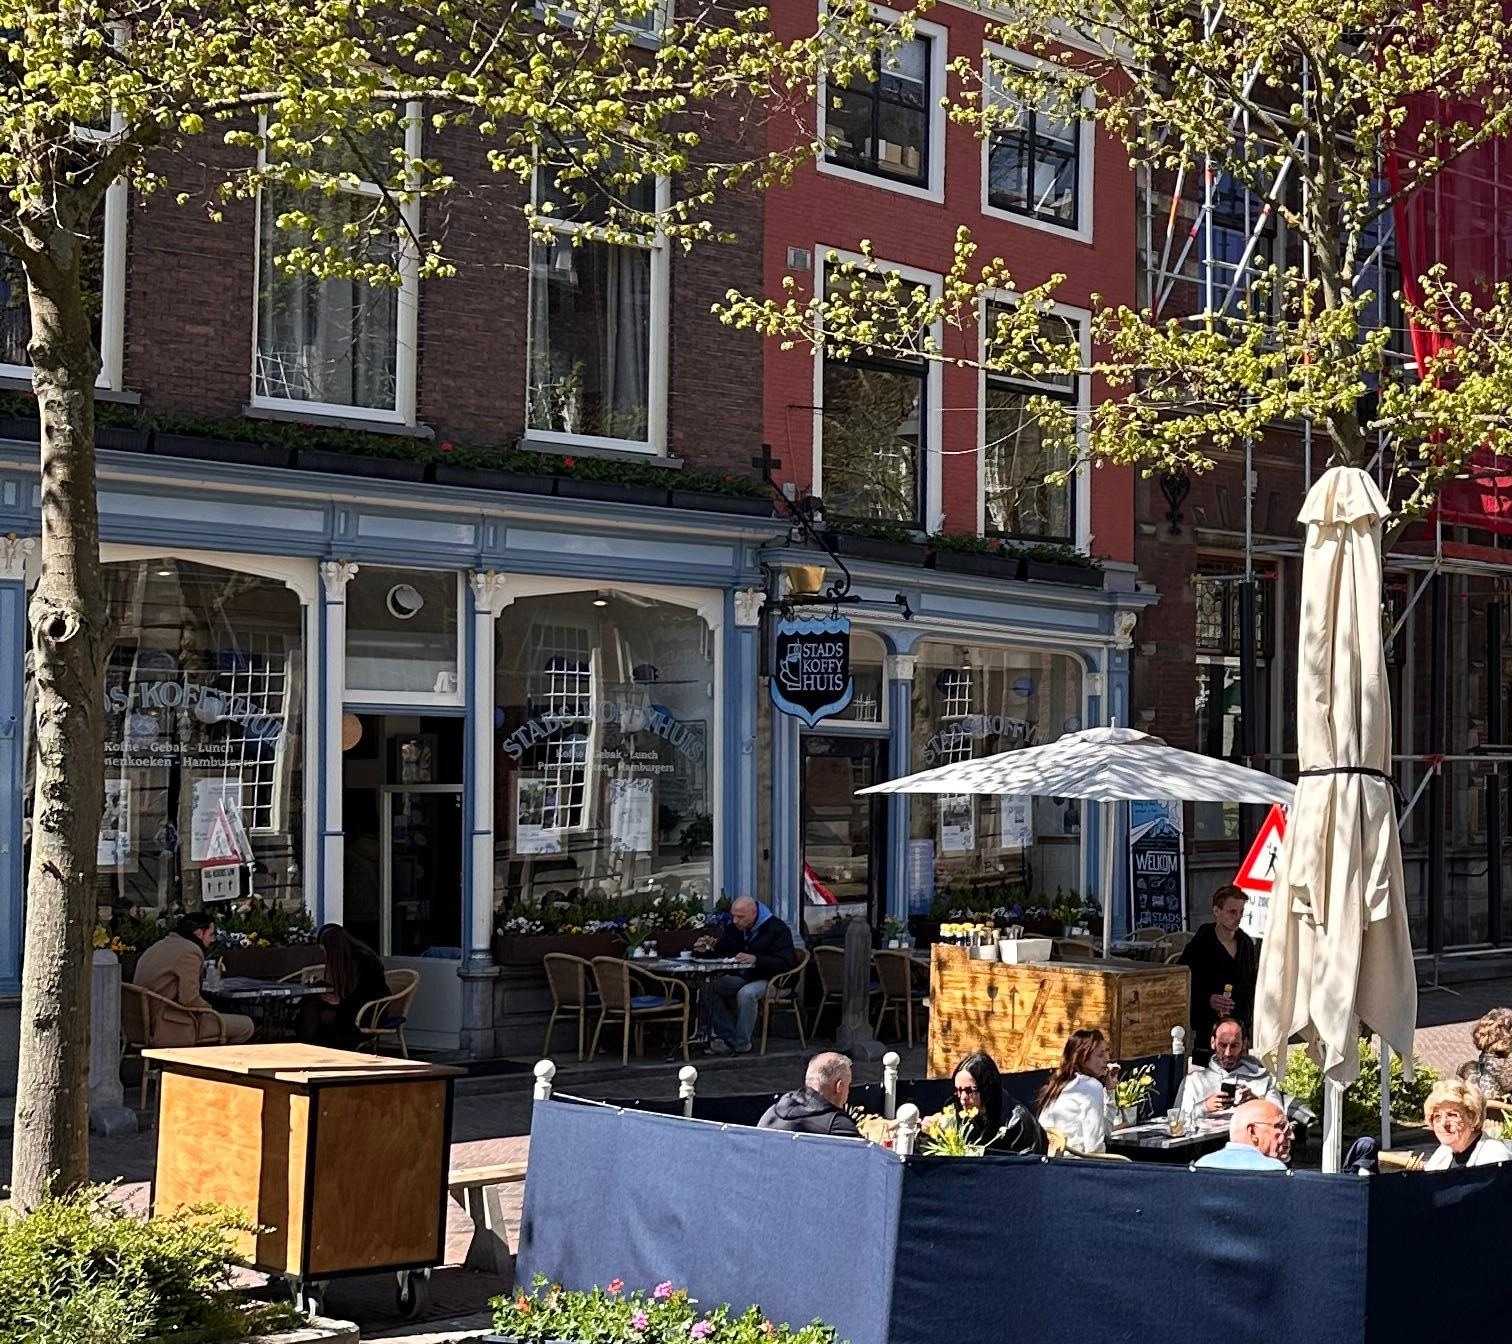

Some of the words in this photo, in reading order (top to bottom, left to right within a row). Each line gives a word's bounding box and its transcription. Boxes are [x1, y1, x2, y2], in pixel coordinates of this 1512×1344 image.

[803, 642, 844, 657] STADS
[803, 658, 844, 673] KOFFY
[803, 674, 844, 691] HUIS
[150, 741, 188, 753] Gebak
[198, 741, 234, 753] Lunch
[104, 756, 172, 768] nenkoeken
[1135, 853, 1178, 872] WELKOM
[1152, 912, 1181, 923] STADS
